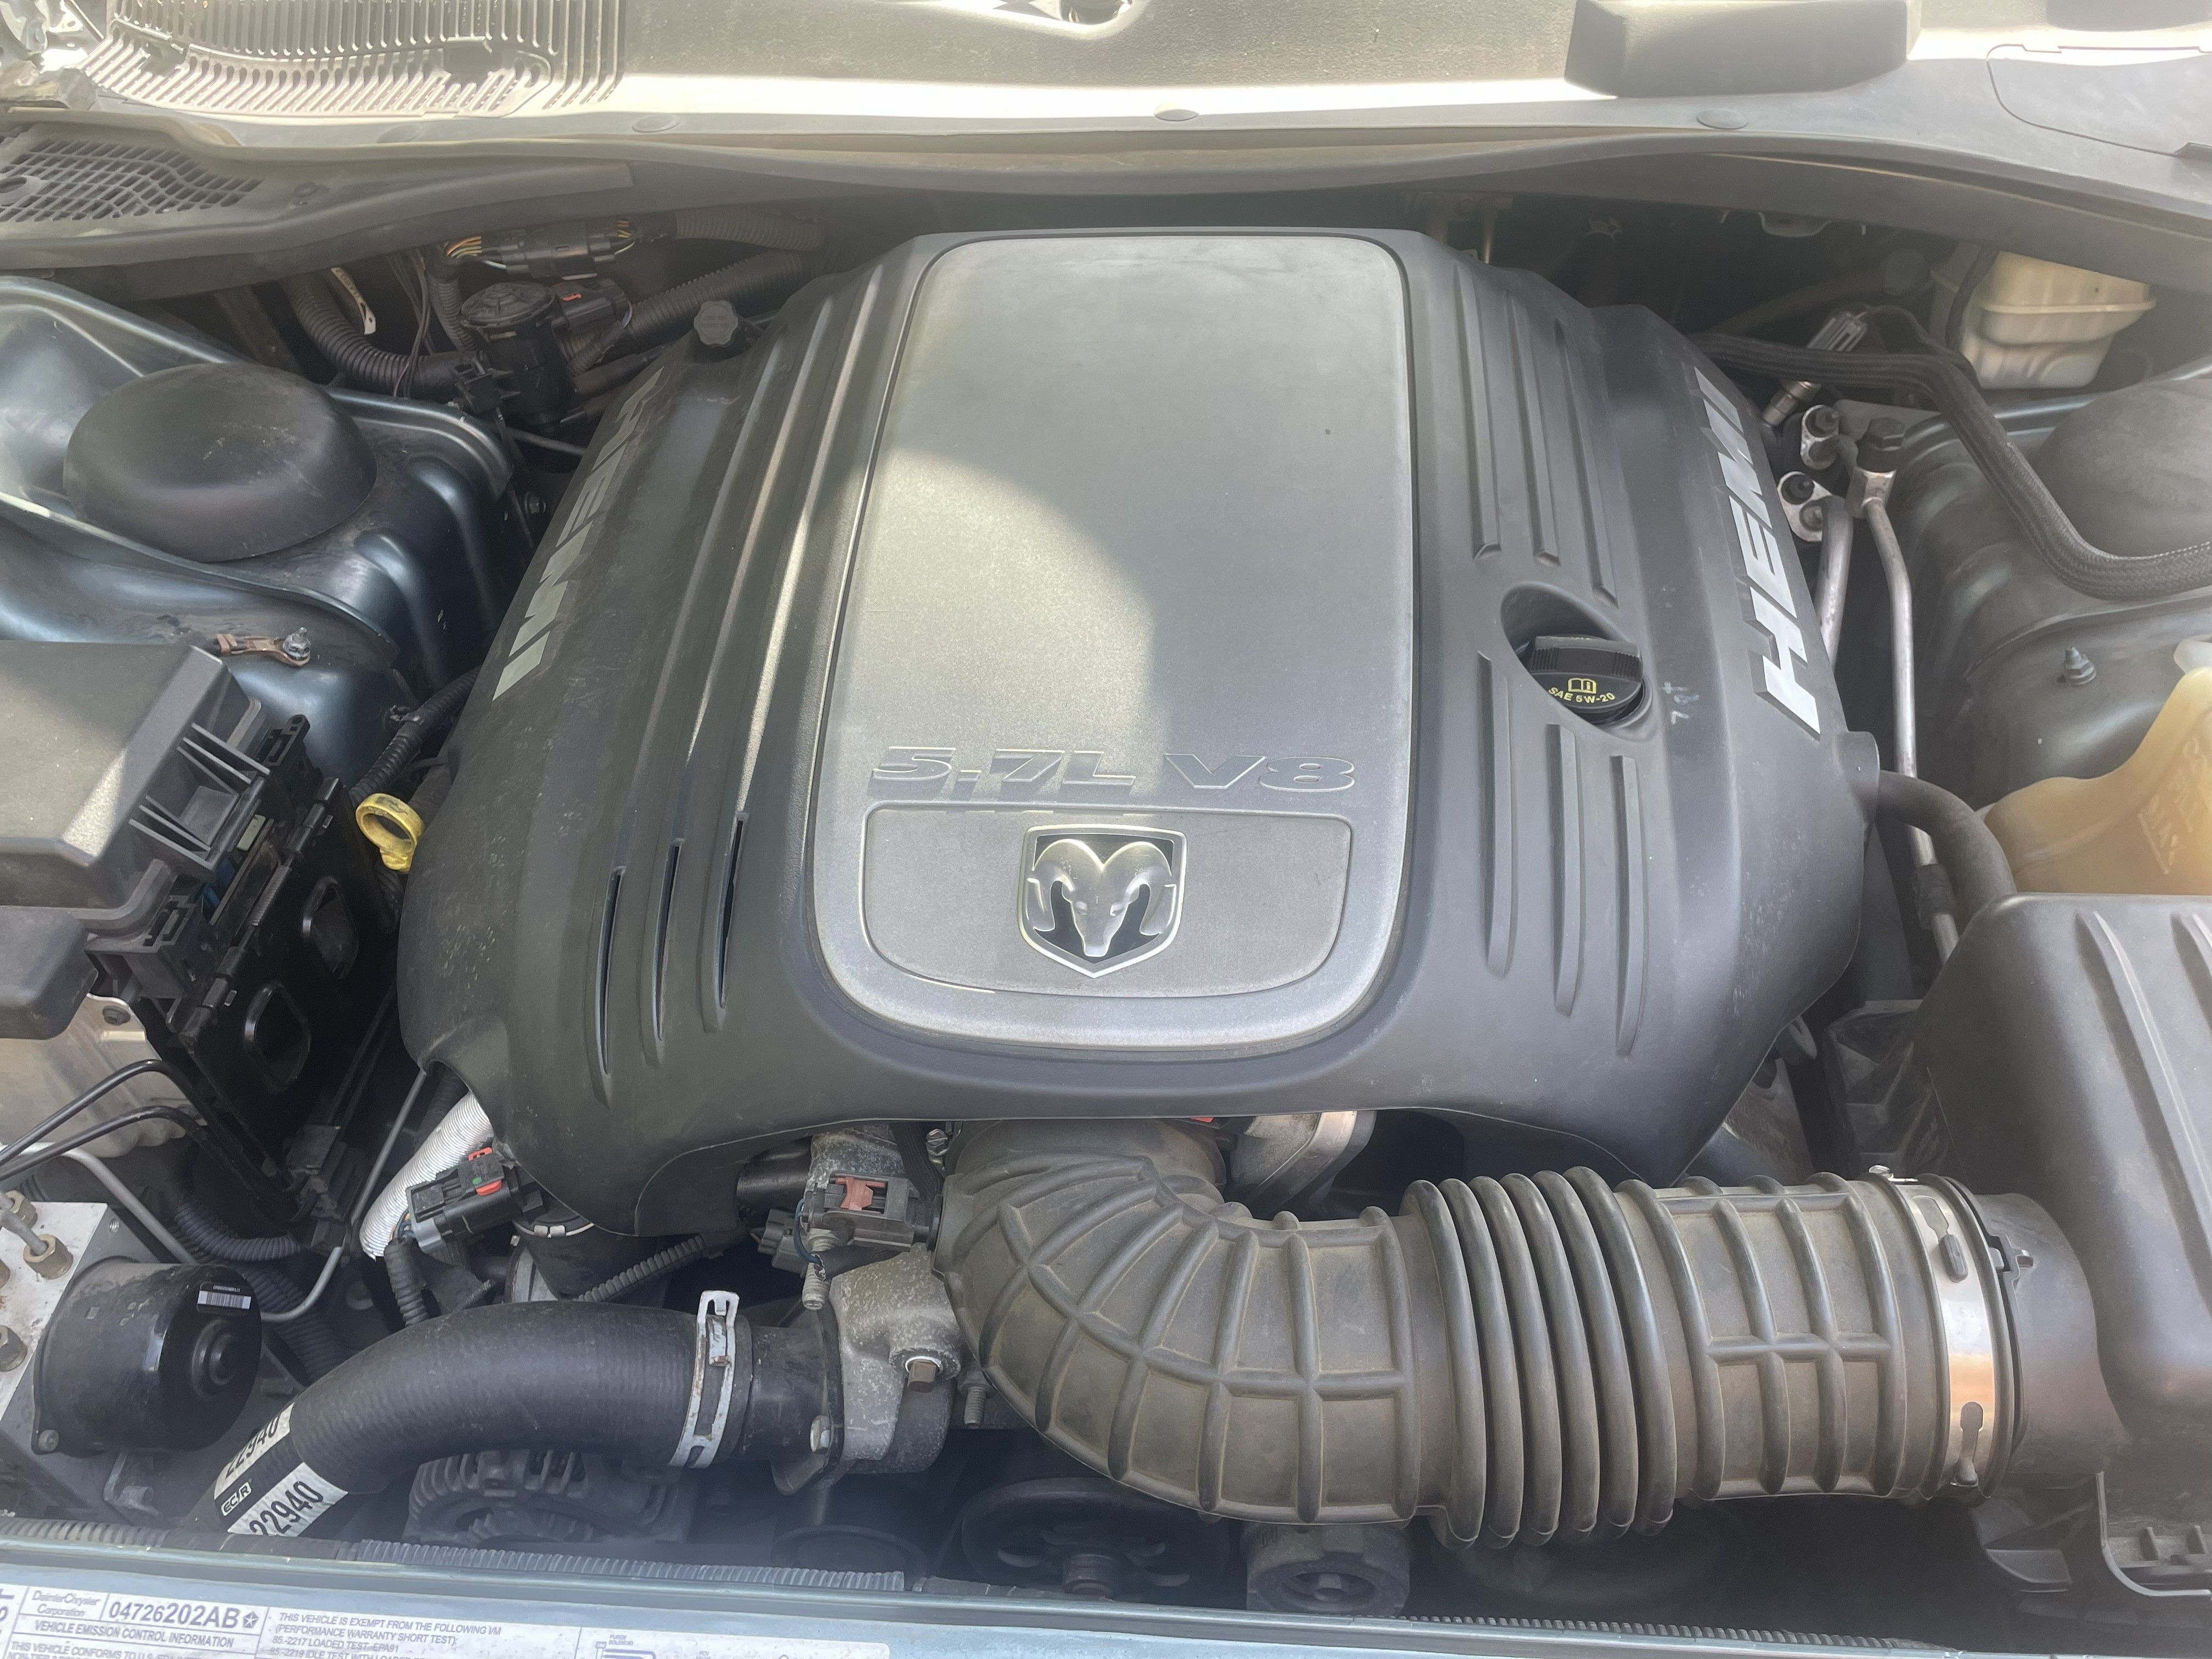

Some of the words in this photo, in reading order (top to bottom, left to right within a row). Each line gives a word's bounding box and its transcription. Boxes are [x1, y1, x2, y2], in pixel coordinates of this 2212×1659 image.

[1694, 366, 1820, 735] HEMI
[1548, 687, 1573, 702] SAE
[1576, 692, 1616, 703] 5W-20
[873, 747, 1136, 786] 5.7L
[1161, 753, 1355, 792] V8
[250, 1481, 324, 1536] 22940
[37, 1603, 86, 1617] Corporation
[109, 1601, 240, 1629] 04726202AB
[35, 1620, 75, 1634] VEHICLE
[75, 1623, 121, 1638] EMISSION
[122, 1628, 166, 1641] CONTROL
[168, 1632, 235, 1648] INFORMATION
[275, 1623, 346, 1638] (PERFORMANCE
[347, 1628, 398, 1641] WARRANTY
[397, 1632, 430, 1643] SHORT
[279, 1612, 300, 1622] THIS
[301, 1614, 338, 1625] VEHICLE
[338, 1617, 348, 1626] IS
[349, 1617, 386, 1628] EXEMPT
[386, 1620, 414, 1630] FROM
[415, 1622, 432, 1632] THE
[434, 1623, 487, 1634] FOLLOWING
[308, 1638, 345, 1650] LOADED
[346, 1640, 369, 1651] TEST
